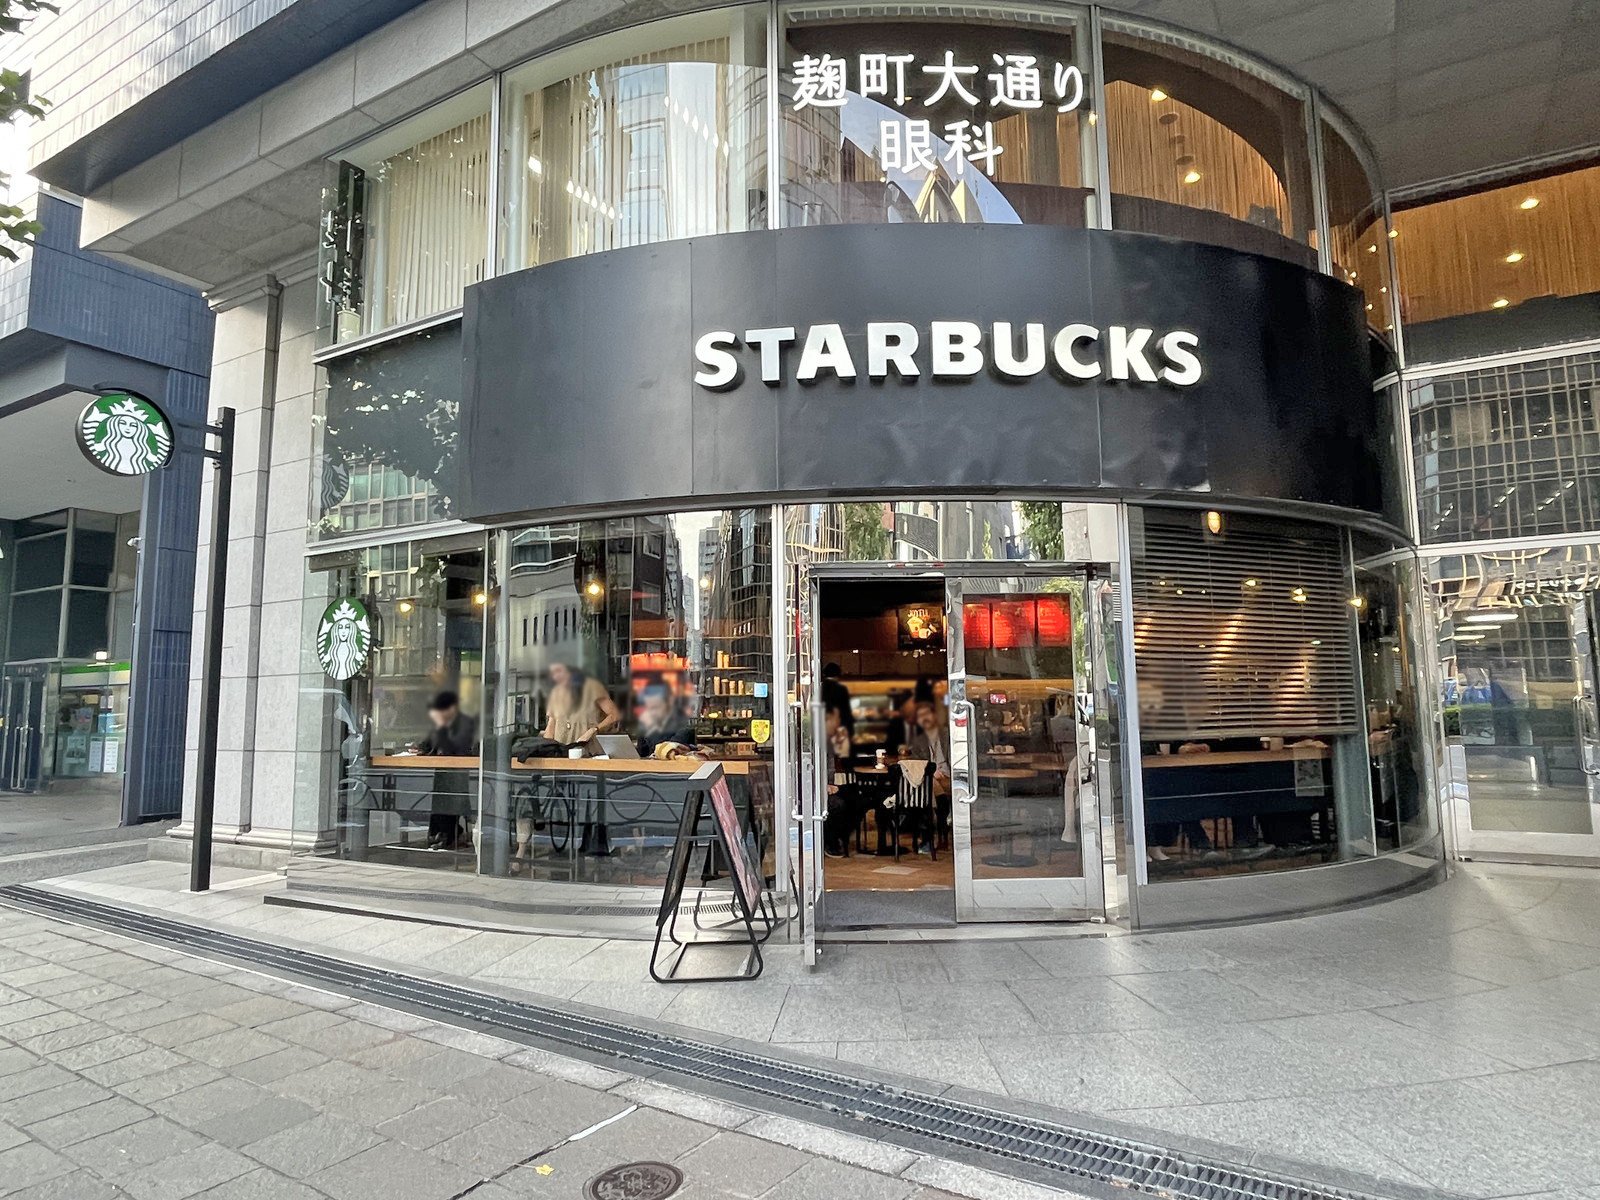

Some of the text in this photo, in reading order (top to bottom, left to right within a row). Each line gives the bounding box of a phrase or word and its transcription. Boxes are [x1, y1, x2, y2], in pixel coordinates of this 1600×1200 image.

[791, 50, 1084, 113] 麹町大通り
[880, 119, 1004, 176] 眼科
[693, 320, 1204, 388] STARBUCKS
